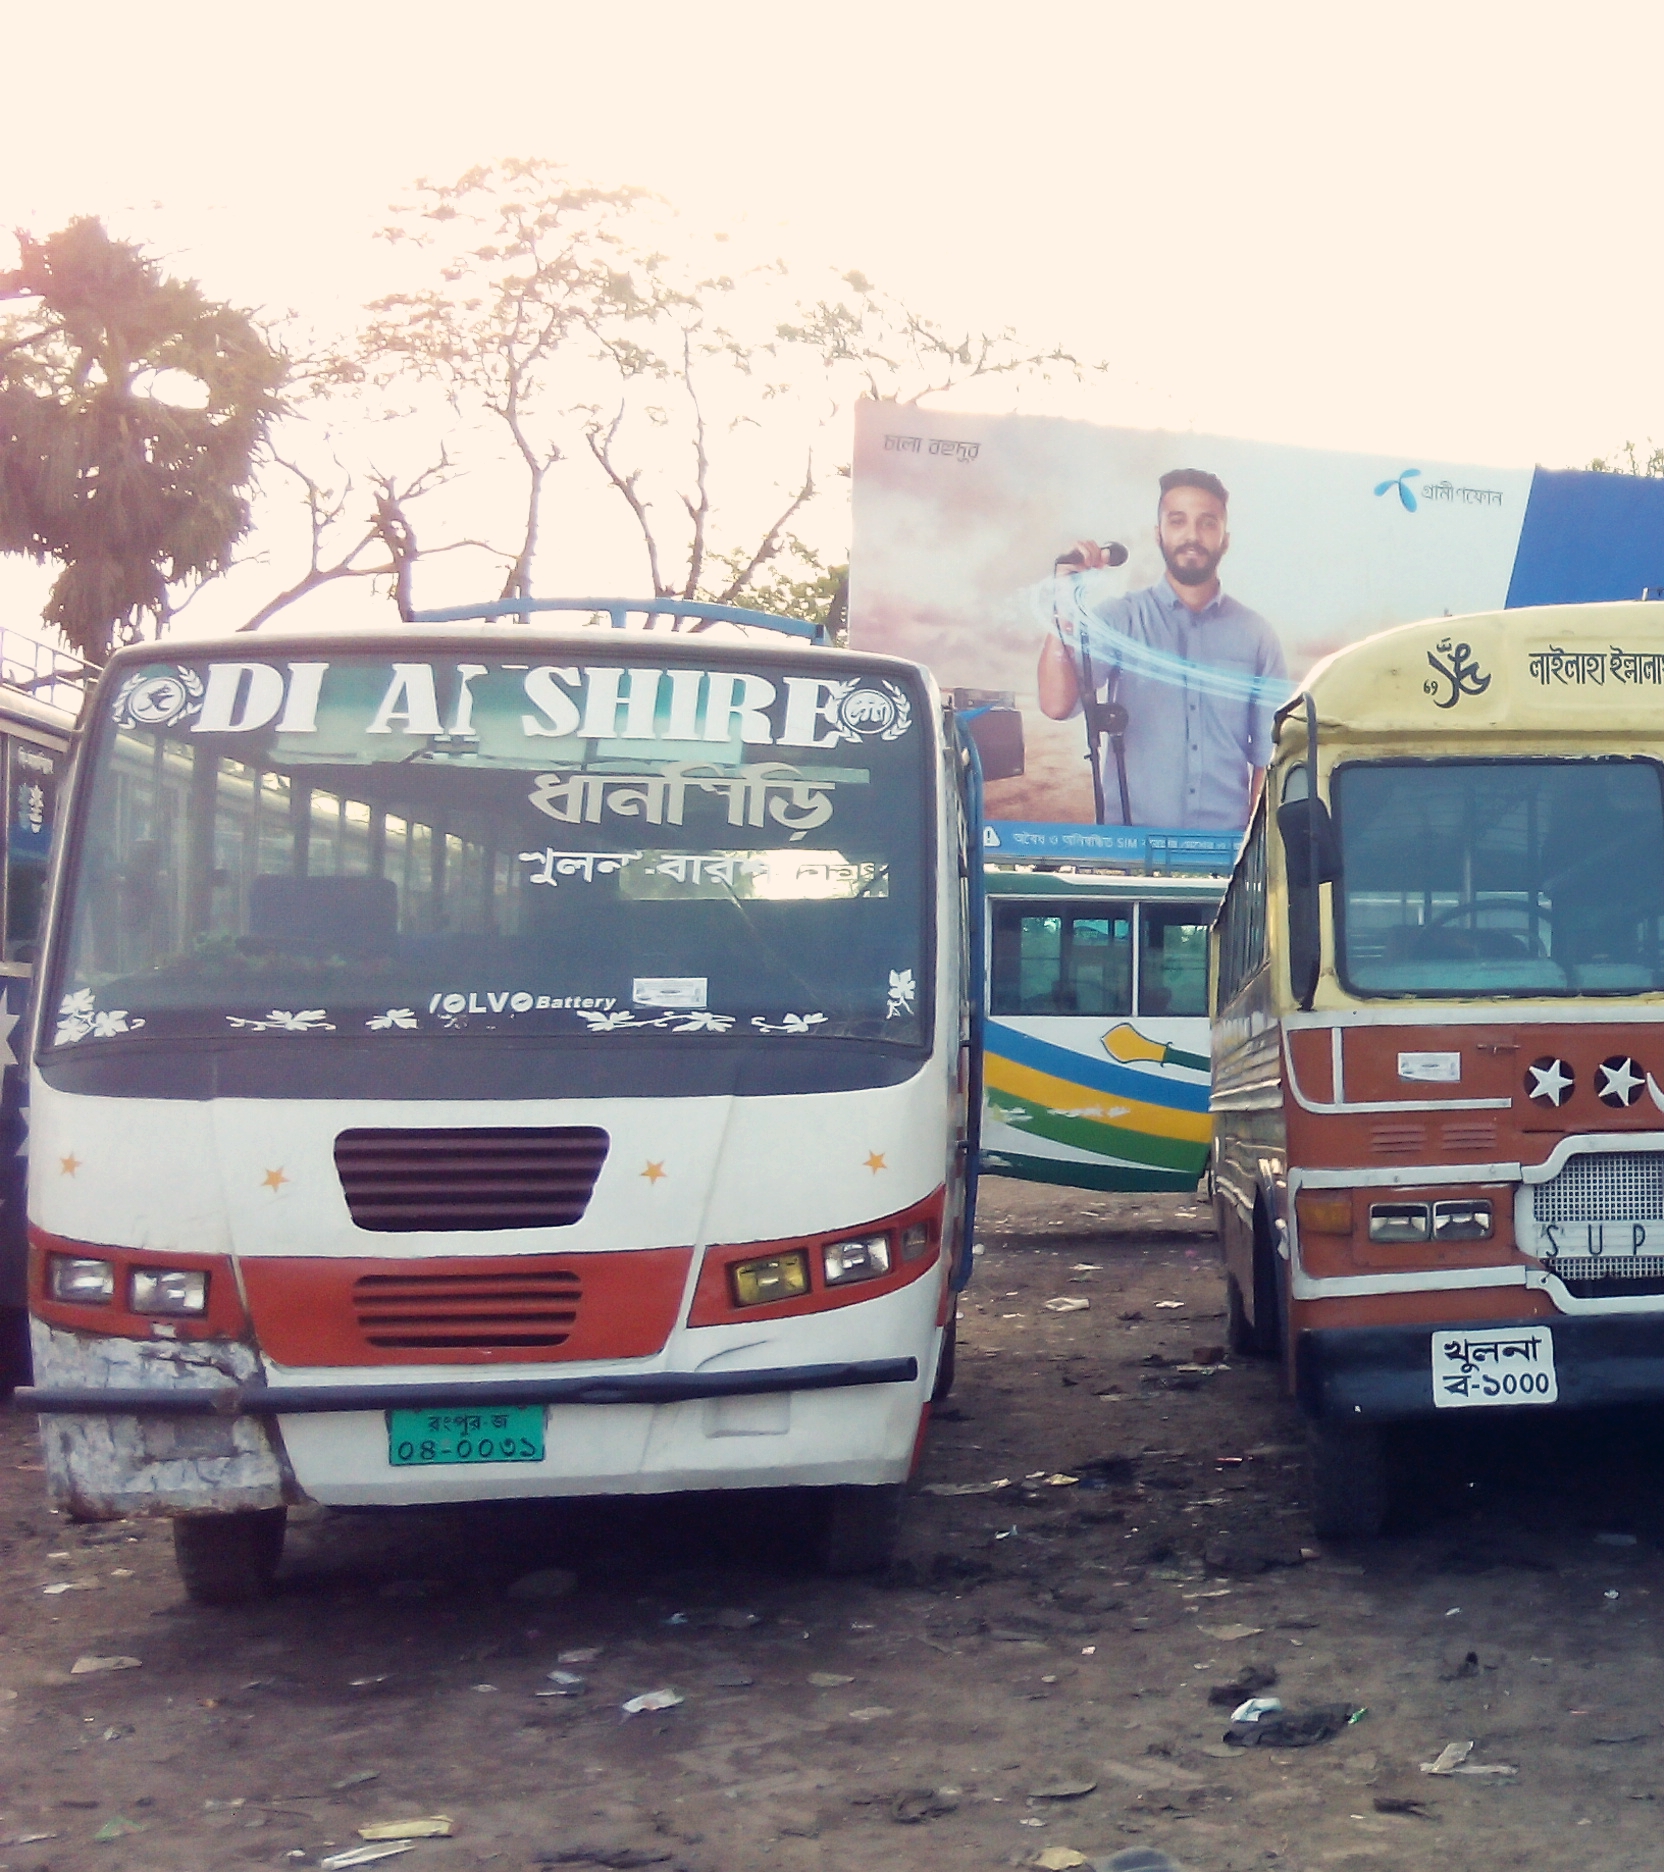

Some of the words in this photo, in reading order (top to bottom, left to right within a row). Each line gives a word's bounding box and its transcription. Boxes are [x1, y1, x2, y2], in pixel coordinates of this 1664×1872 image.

[1421, 480, 1503, 506] গ্রামীণফোন
[1528, 644, 1607, 685] লাইলাহা
[521, 666, 840, 749] SHIRE
[1117, 838, 1138, 848] SIM
[536, 996, 616, 1011] Battery
[1443, 1335, 1542, 1374] খুলনা
